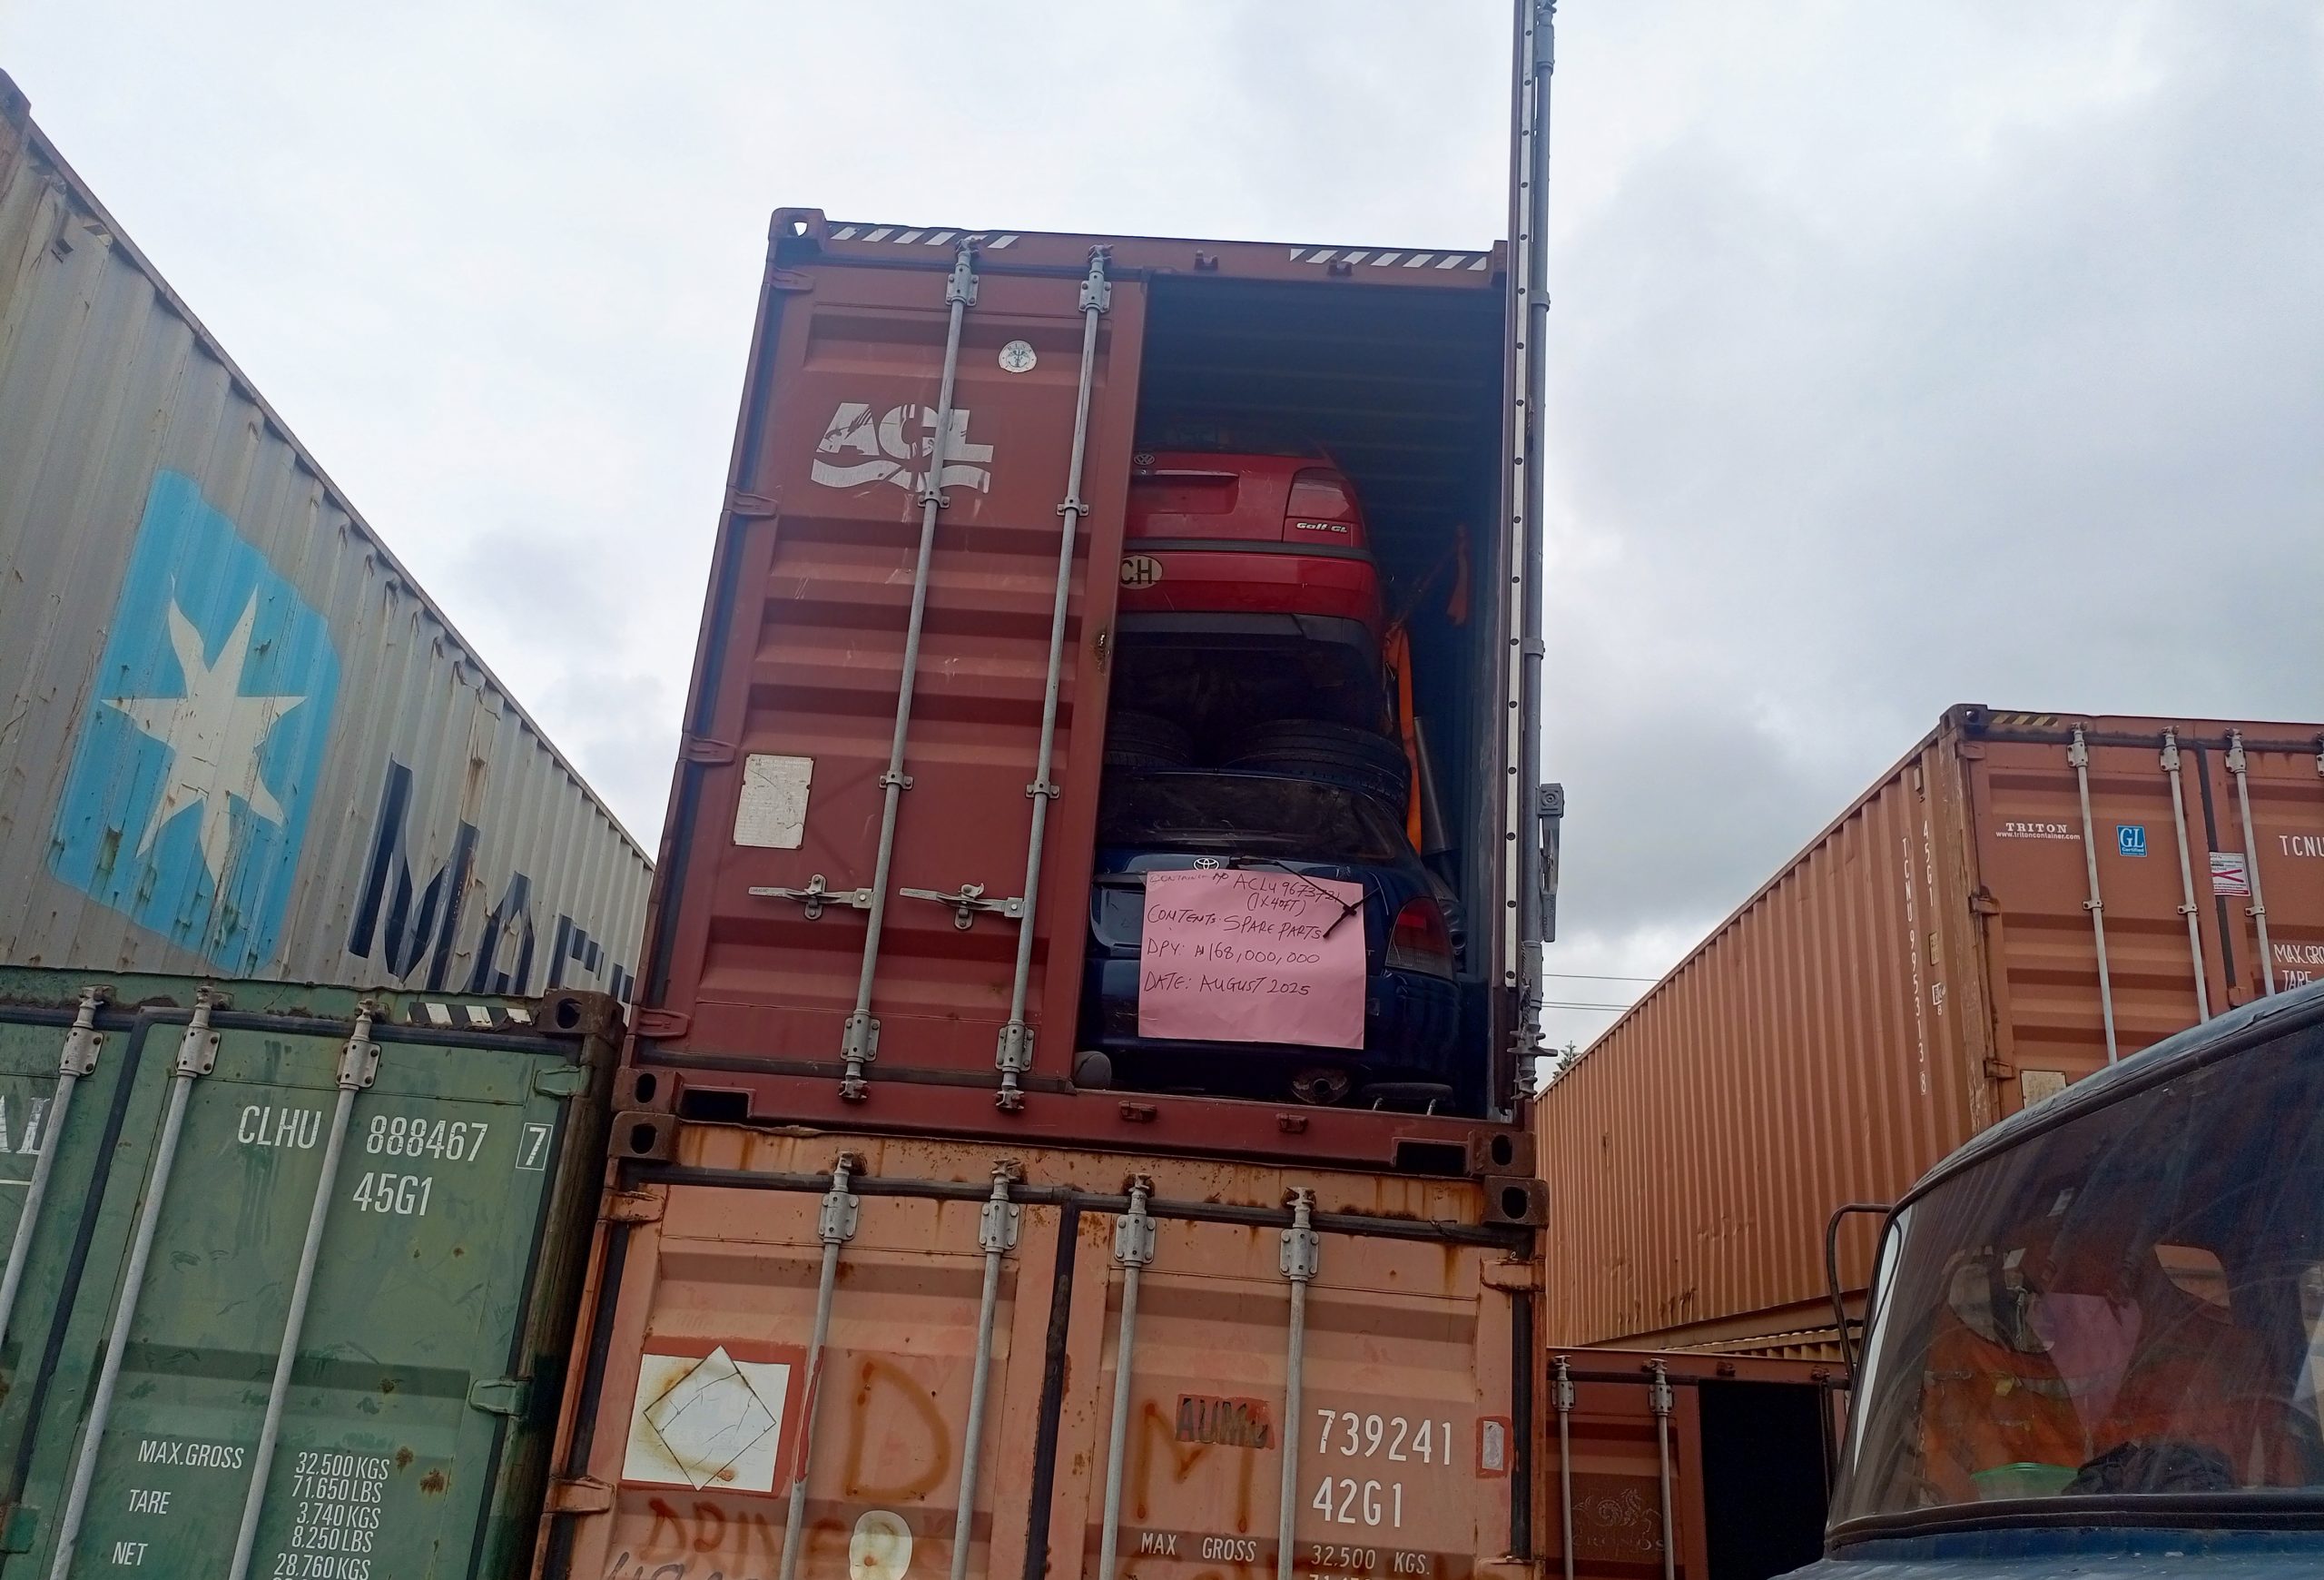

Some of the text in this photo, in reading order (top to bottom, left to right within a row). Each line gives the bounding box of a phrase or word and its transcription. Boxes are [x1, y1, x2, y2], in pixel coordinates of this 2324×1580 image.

[1295, 522, 1328, 530] Golf
[1120, 558, 1153, 585] CH
[1995, 831, 2081, 840] www.tritoncontainer.com
[2005, 822, 2068, 834] TRITON
[2120, 827, 2144, 848] GL
[1223, 915, 1275, 933] SPARE
[1278, 922, 1322, 941] PARTS
[1199, 974, 1267, 995] AUGUST
[1266, 981, 1312, 996] 2025
[238, 1105, 547, 1166] CLHU 888467 7
[352, 1172, 433, 1217] 45G1
[1317, 1409, 1452, 1466] 739241
[128, 1488, 171, 1515] TARE
[1313, 1476, 1402, 1528] 42G1
[112, 1541, 148, 1565] NET
[1140, 1532, 1177, 1555] MAX
[1202, 1537, 1256, 1562] GROSS
[1393, 1551, 1431, 1575] KGS.
